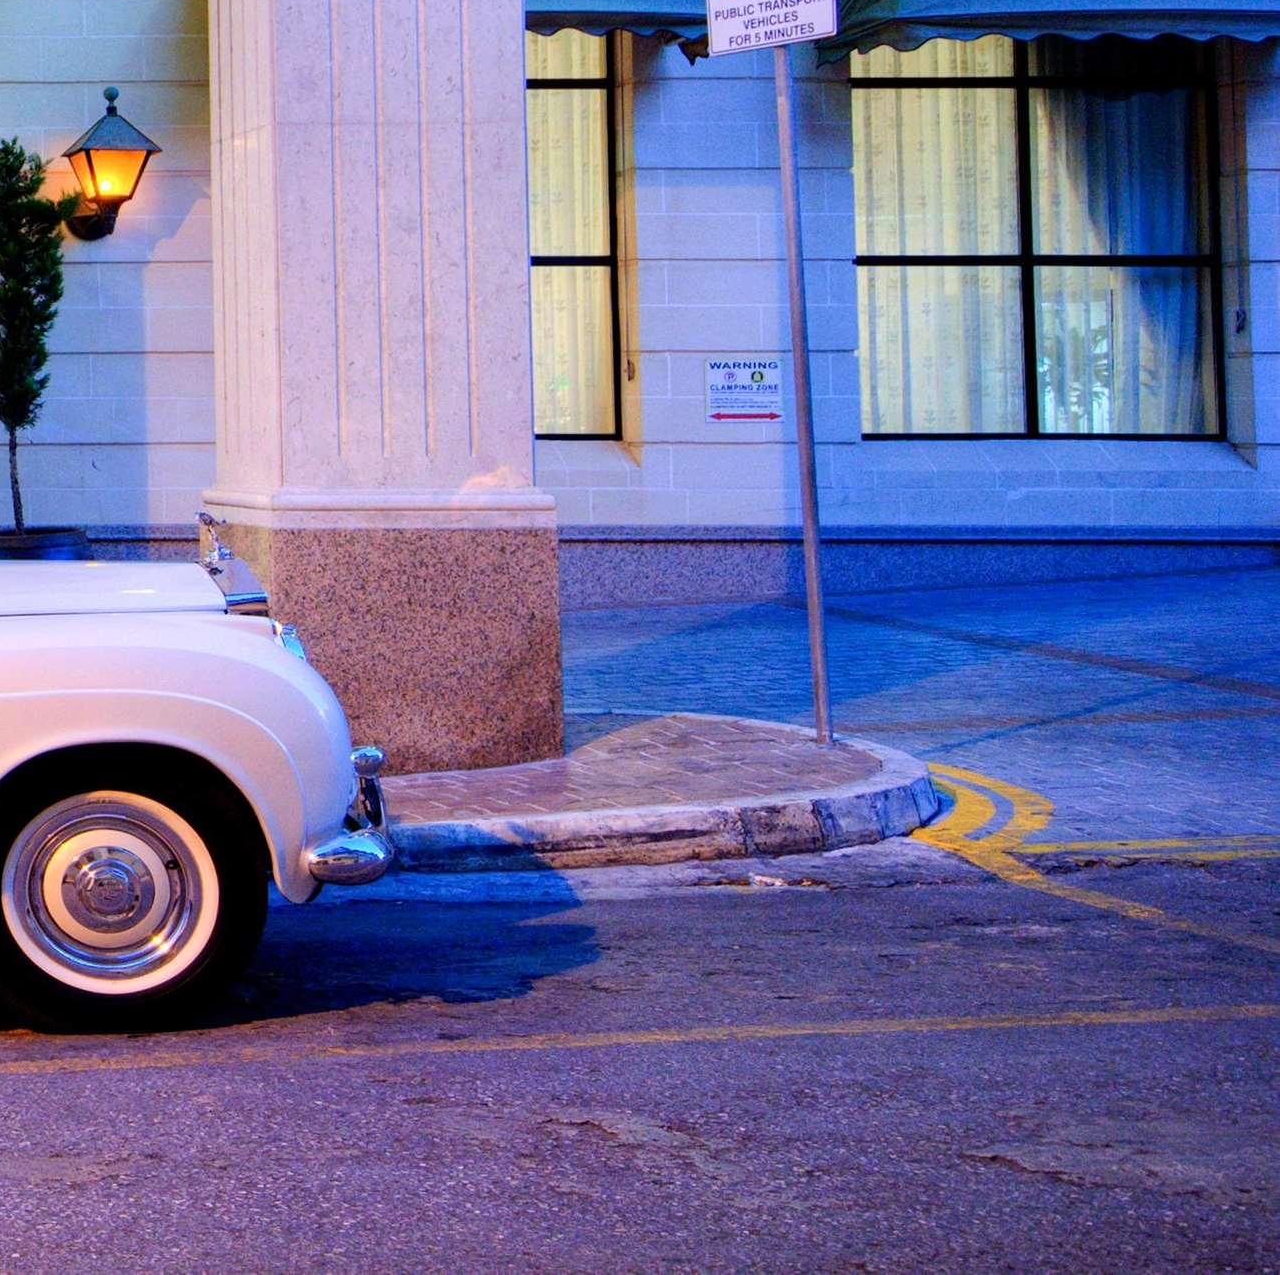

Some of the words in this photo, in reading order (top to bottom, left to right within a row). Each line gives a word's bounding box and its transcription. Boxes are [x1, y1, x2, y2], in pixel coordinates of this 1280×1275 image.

[714, 4, 755, 21] PUBLIC
[743, 11, 799, 30] VEHICLES
[729, 34, 752, 47] FOR
[754, 32, 762, 43] 5
[764, 22, 816, 41] MINUTES
[709, 361, 779, 370] WARNING
